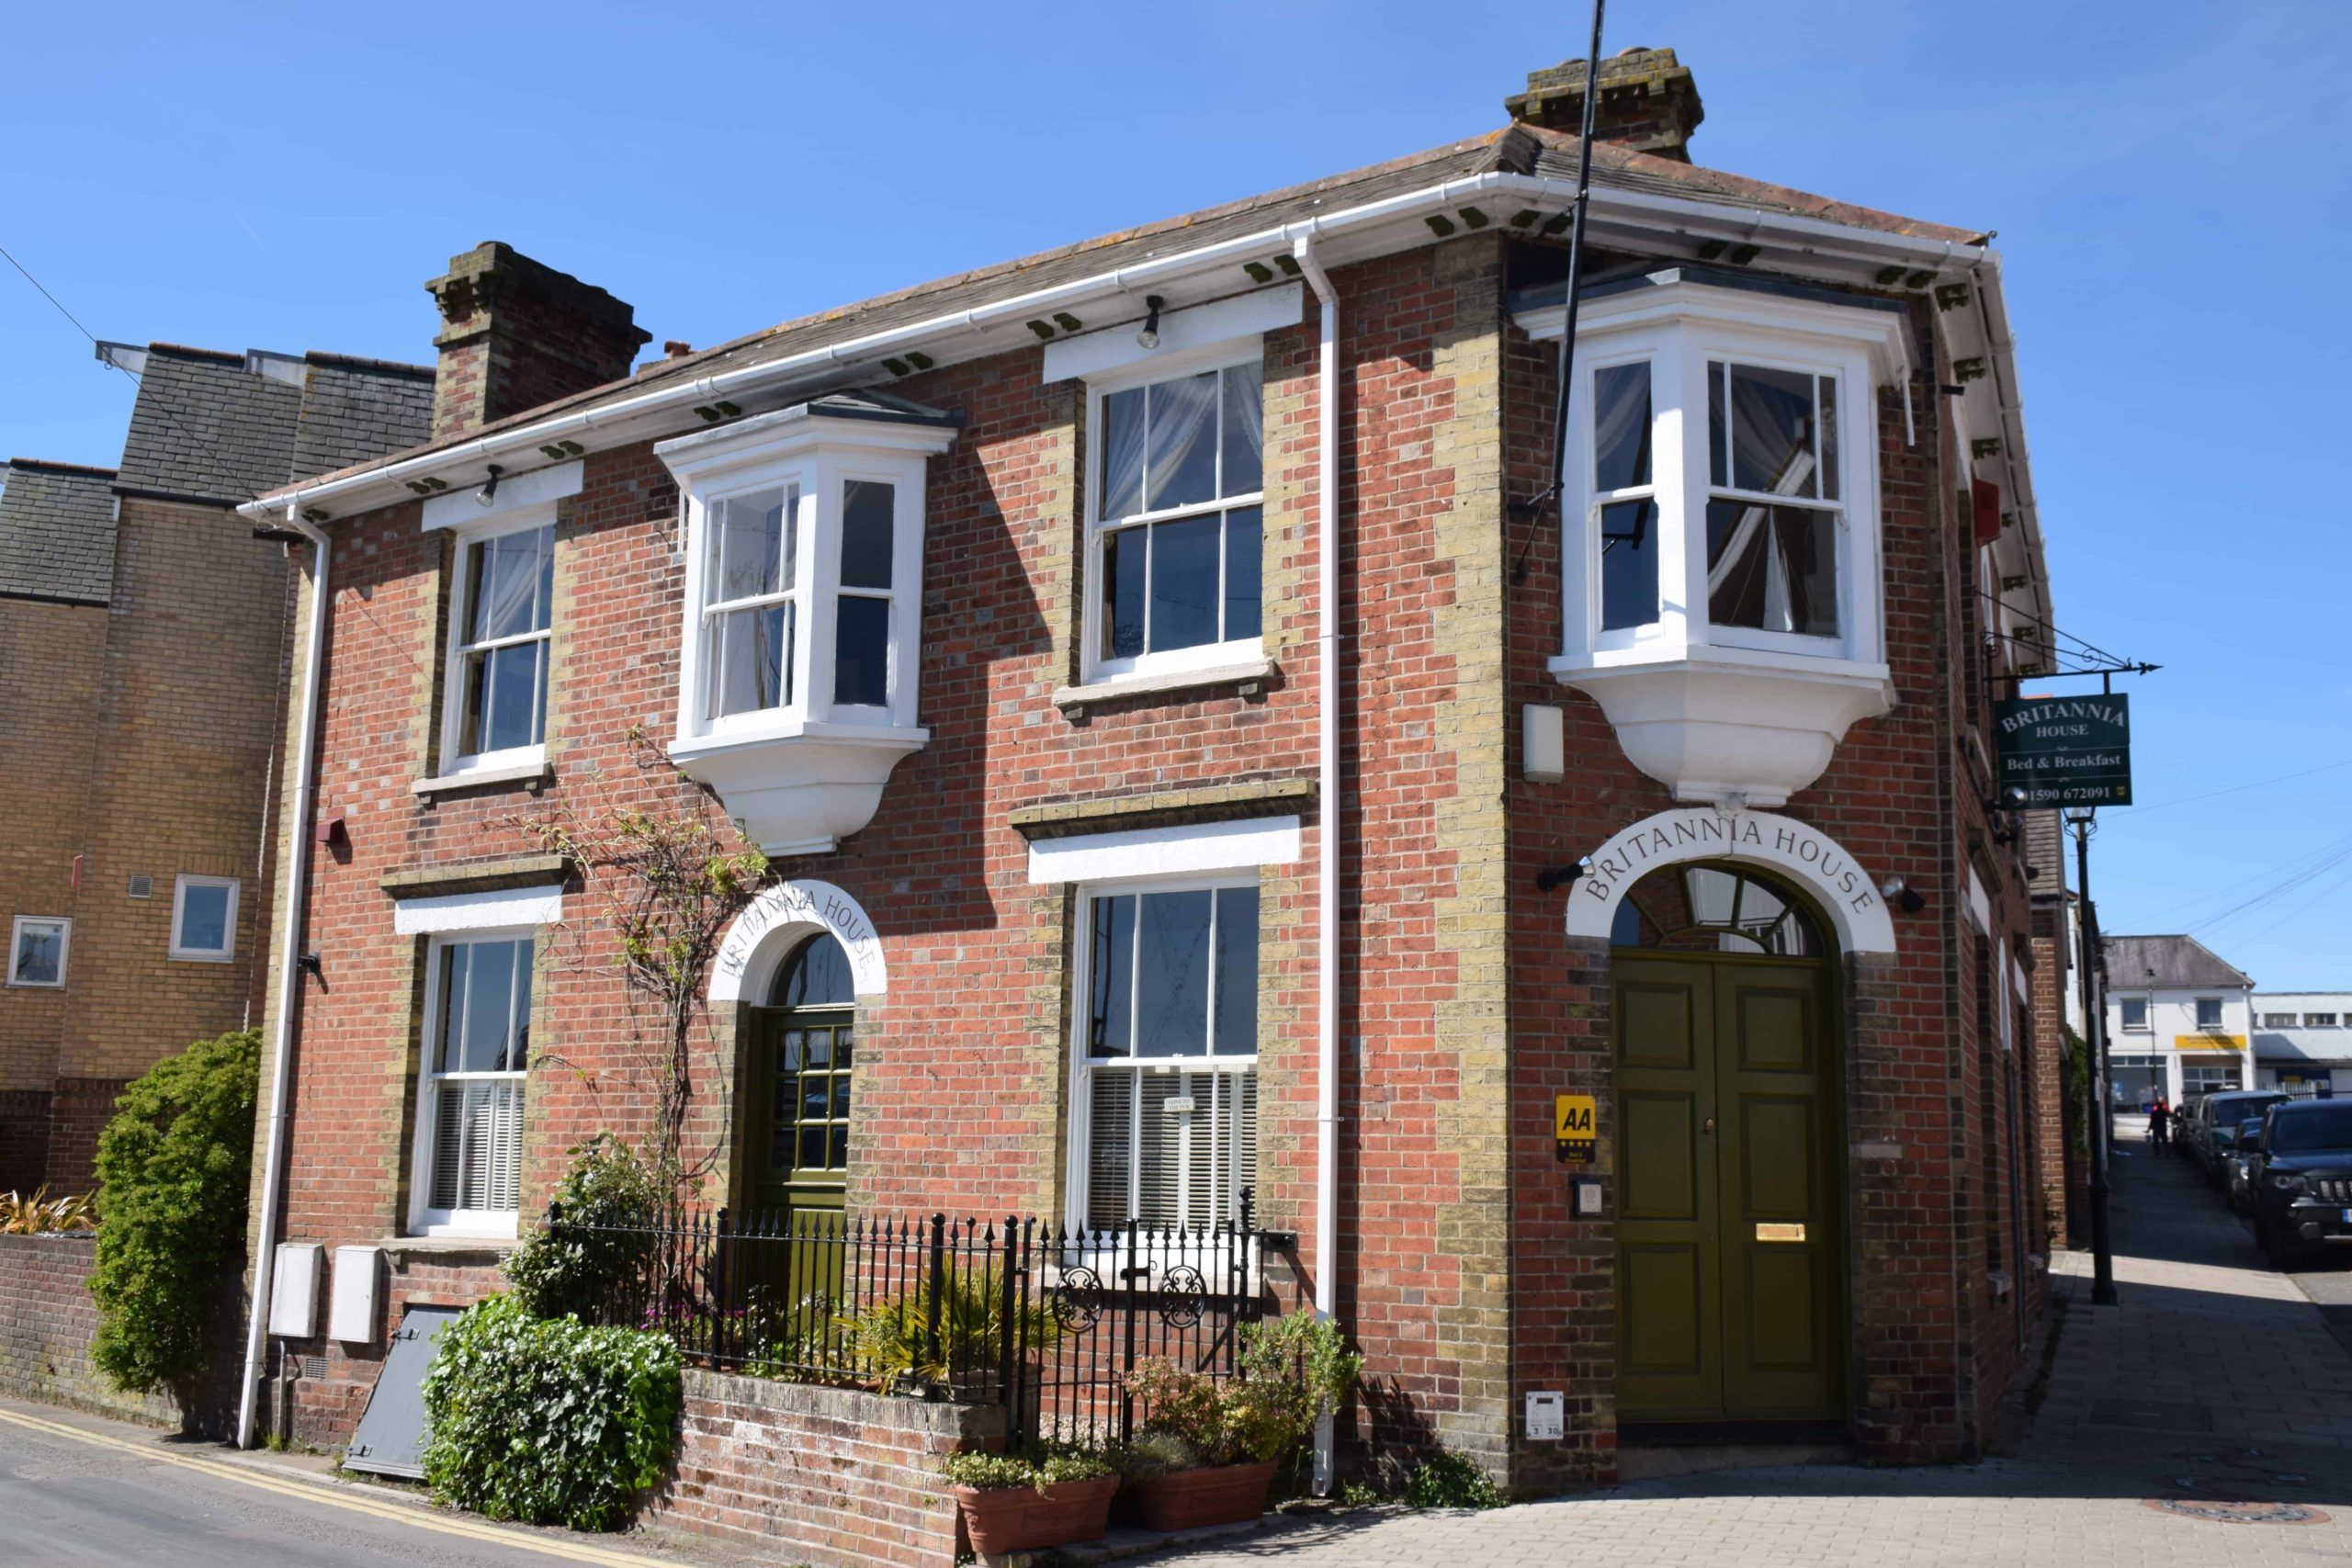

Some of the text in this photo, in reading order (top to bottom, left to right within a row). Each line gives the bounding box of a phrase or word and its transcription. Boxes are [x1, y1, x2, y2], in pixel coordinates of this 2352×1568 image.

[2001, 702, 2124, 733] BRITANNIA
[2036, 724, 2088, 738] HOUSE
[2007, 754, 2120, 771] Bed & Breakfast
[2064, 787, 2110, 800] 672091
[1586, 818, 1873, 914] BRITANNIA HOUSE
[824, 895, 876, 969] HOUSE
[1563, 1108, 1590, 1131] AA
